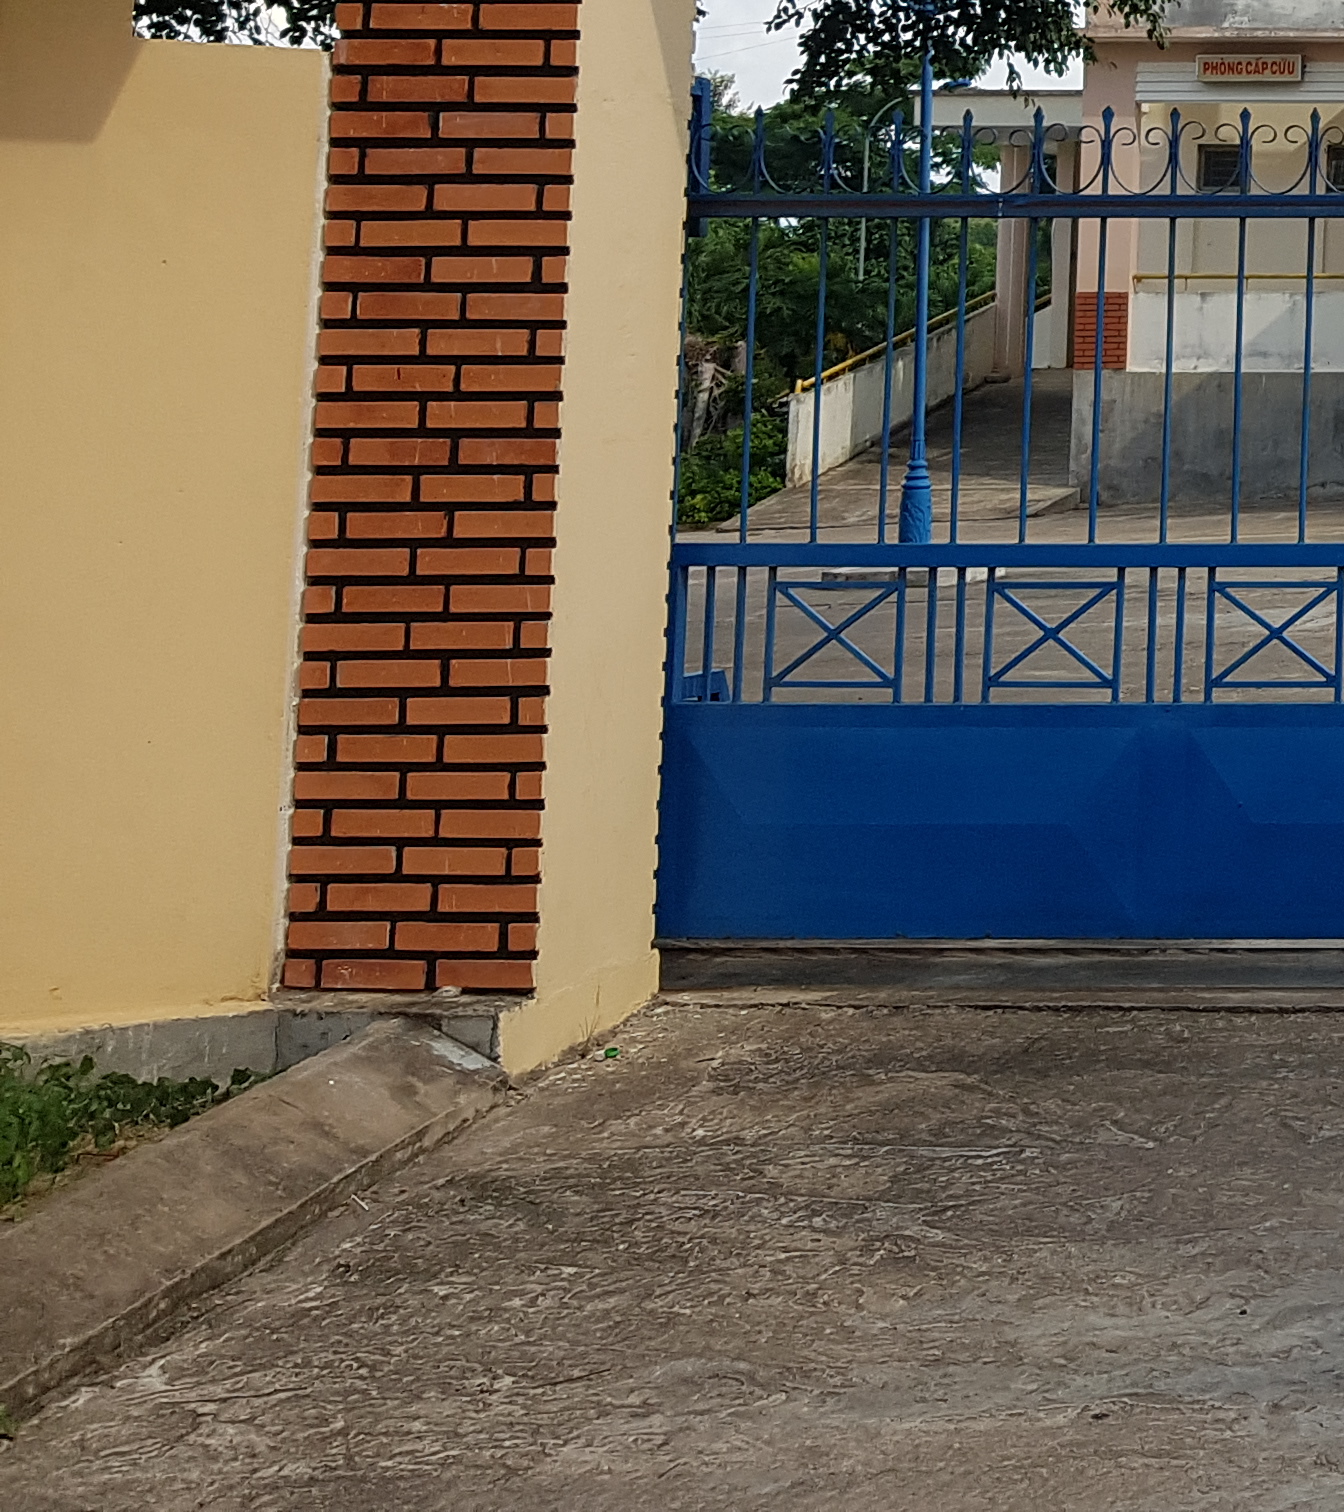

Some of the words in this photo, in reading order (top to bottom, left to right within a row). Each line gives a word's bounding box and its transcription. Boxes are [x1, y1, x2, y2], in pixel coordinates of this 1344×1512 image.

[1203, 57, 1243, 76] PHÒNG
[1245, 56, 1269, 76] CẤP
[1270, 58, 1296, 76] CỨU
